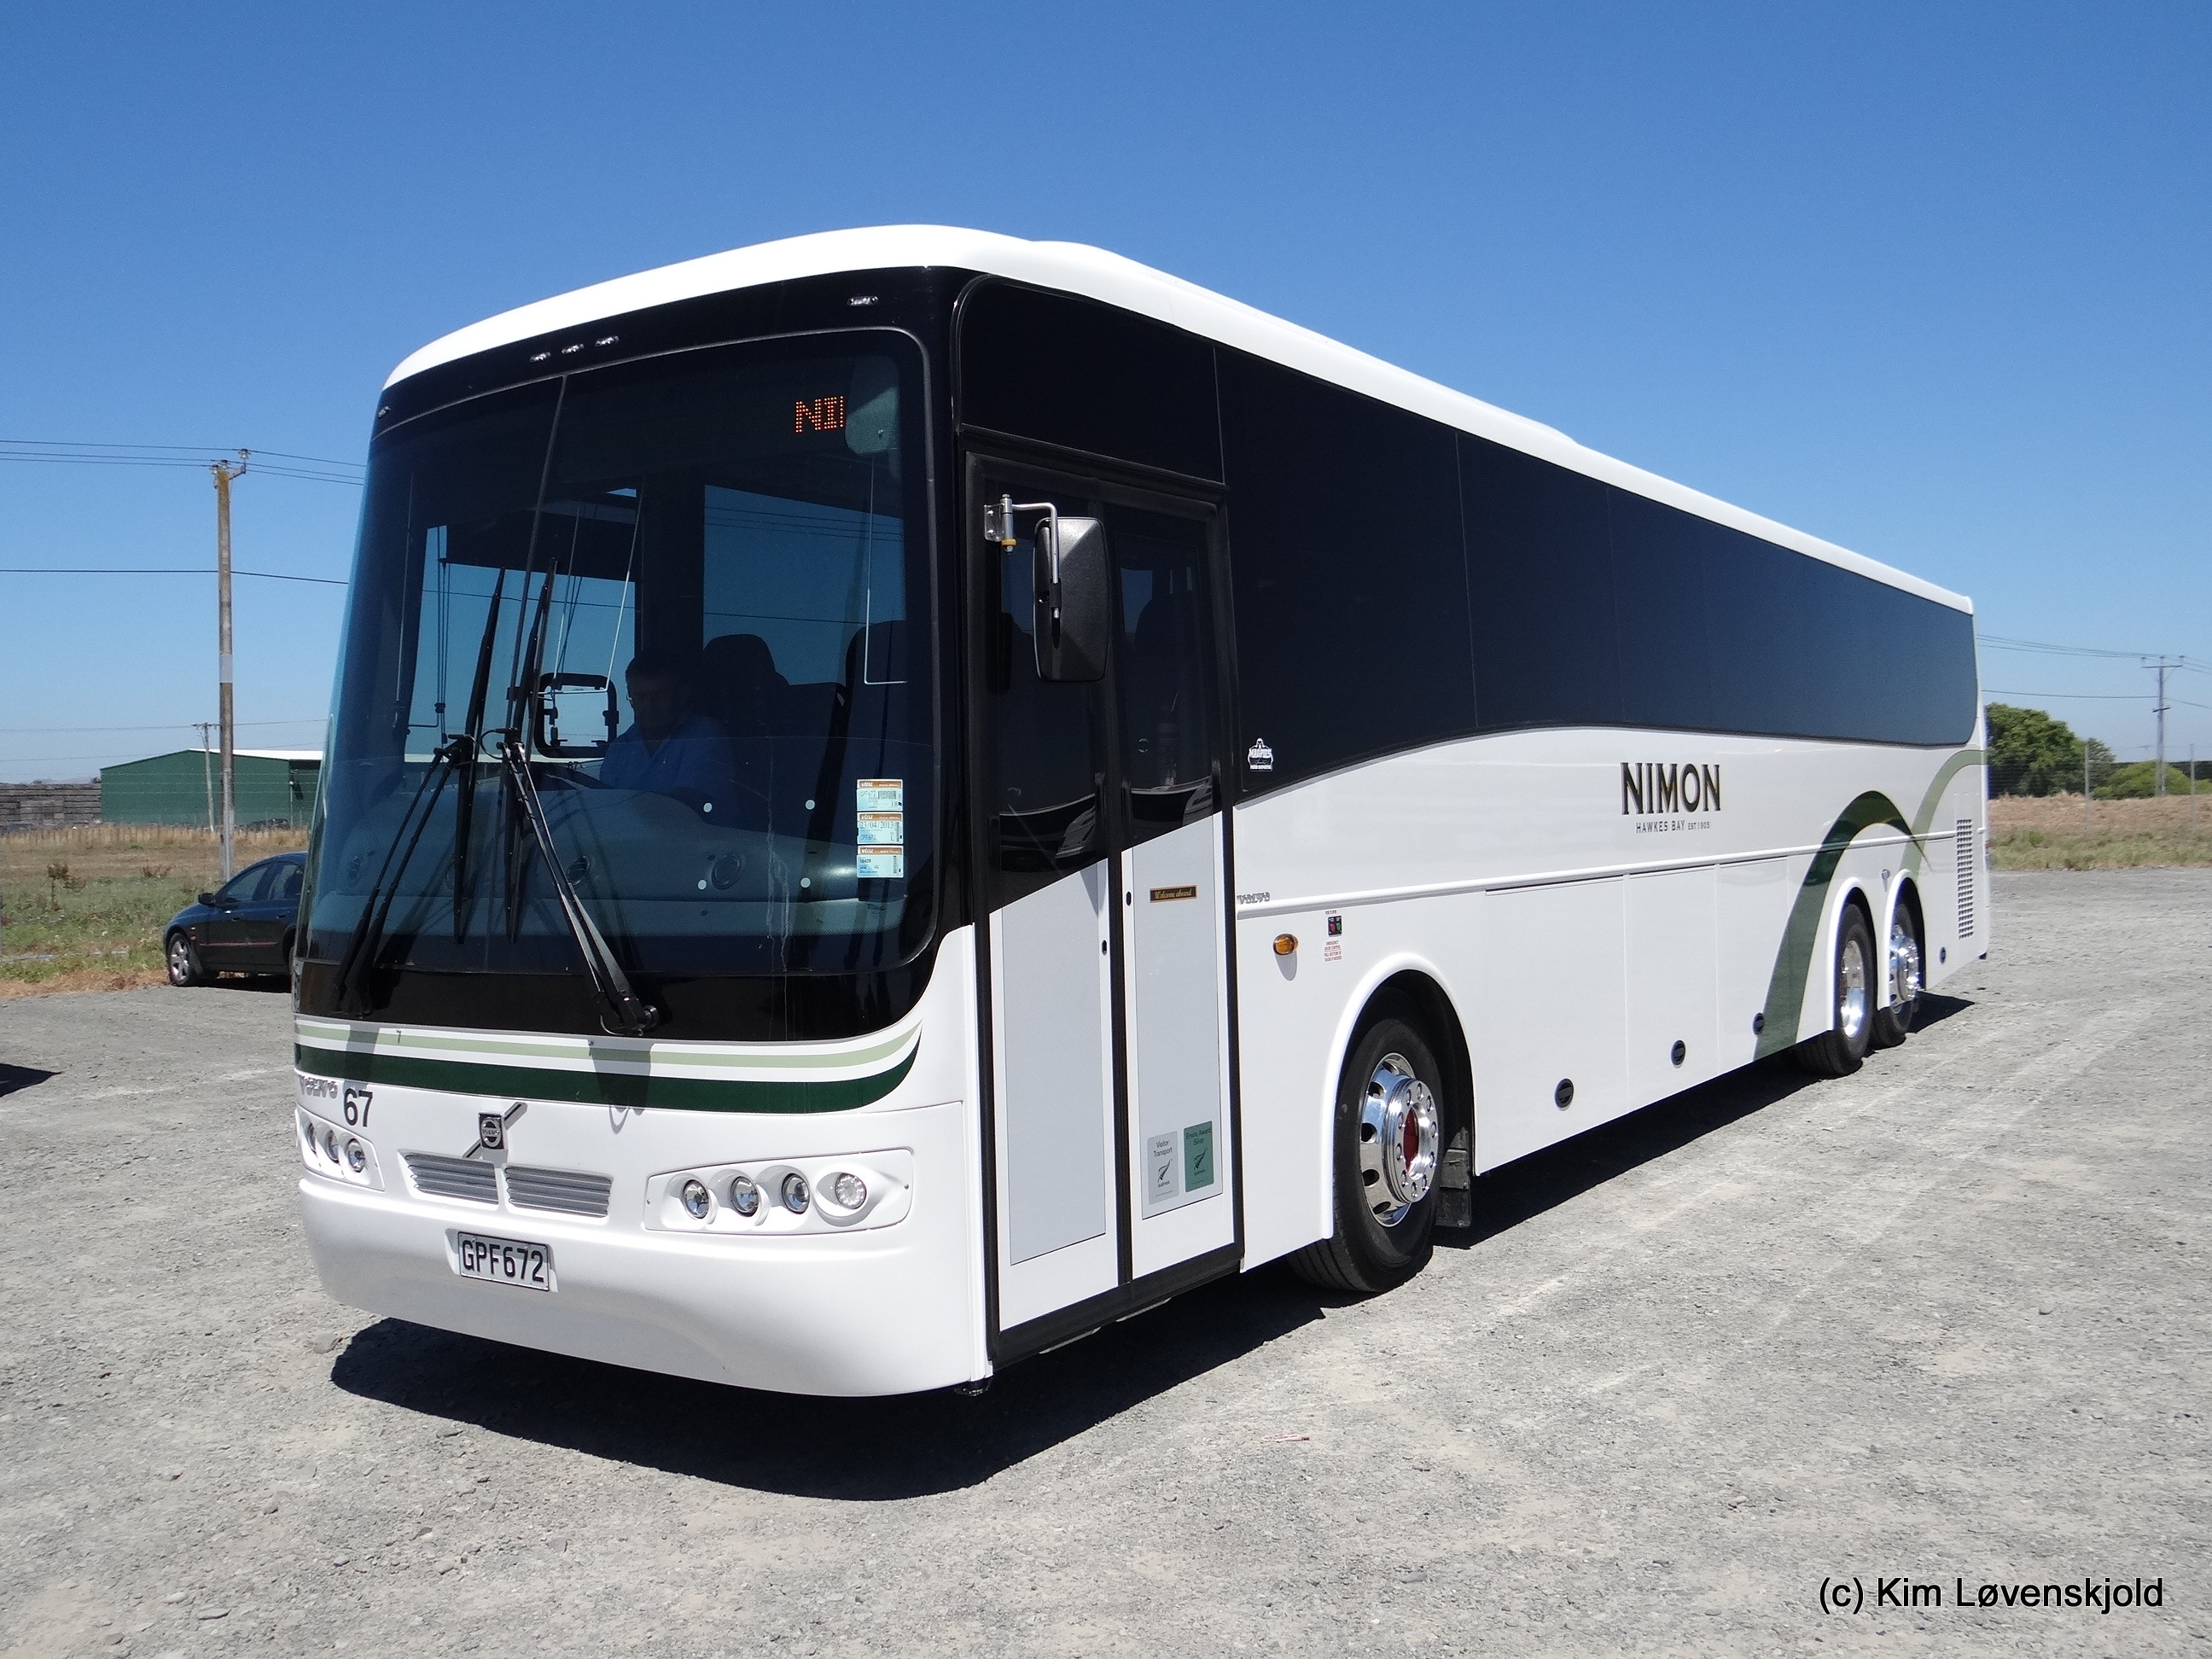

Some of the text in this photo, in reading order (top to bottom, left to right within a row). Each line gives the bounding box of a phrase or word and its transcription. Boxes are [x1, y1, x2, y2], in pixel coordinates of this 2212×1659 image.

[1621, 762, 1720, 815] NIMON
[859, 821, 894, 830] 23/04/2013
[1636, 821, 1668, 834] HAWKES
[1672, 820, 1685, 831] BAY
[344, 1088, 373, 1127] 67
[1156, 1140, 1169, 1149] Visitor
[1153, 1147, 1173, 1158] Transport
[463, 1240, 544, 1283] GPF672
